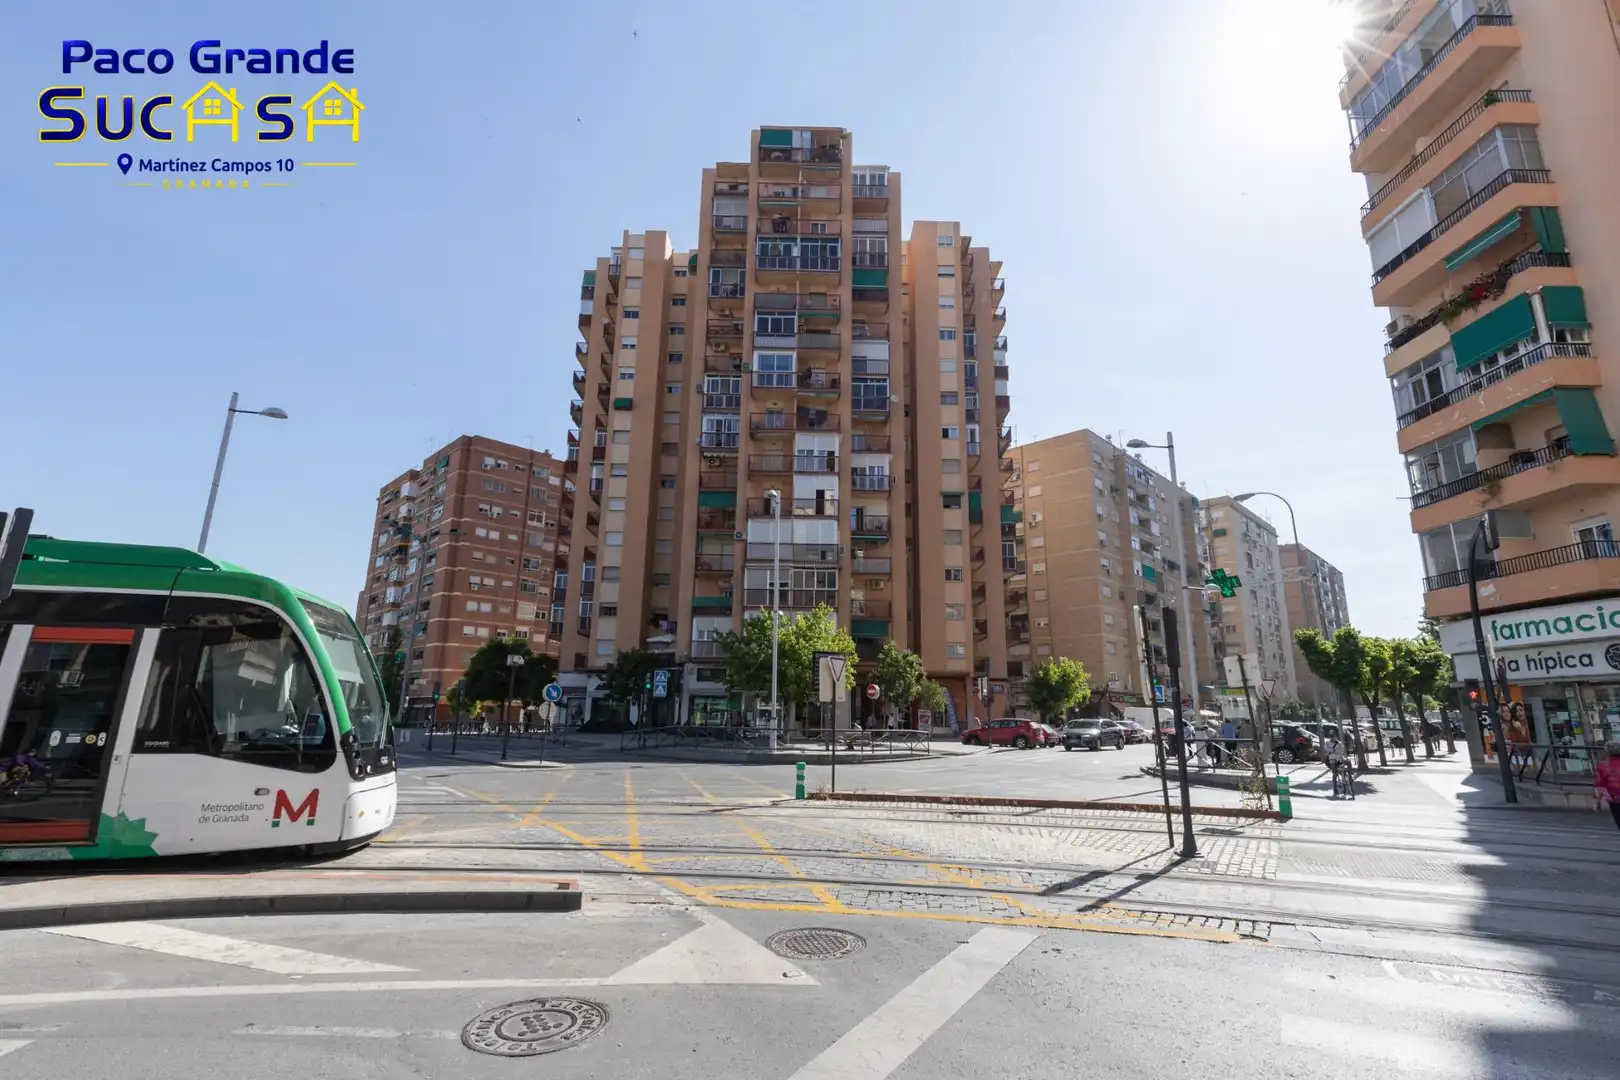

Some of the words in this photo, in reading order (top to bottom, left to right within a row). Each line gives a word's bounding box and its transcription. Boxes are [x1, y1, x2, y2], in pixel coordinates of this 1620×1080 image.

[1525, 651, 1594, 674] hípica
[201, 803, 264, 813] Metropolitano
[198, 816, 210, 824] de
[212, 814, 249, 824] Granada
